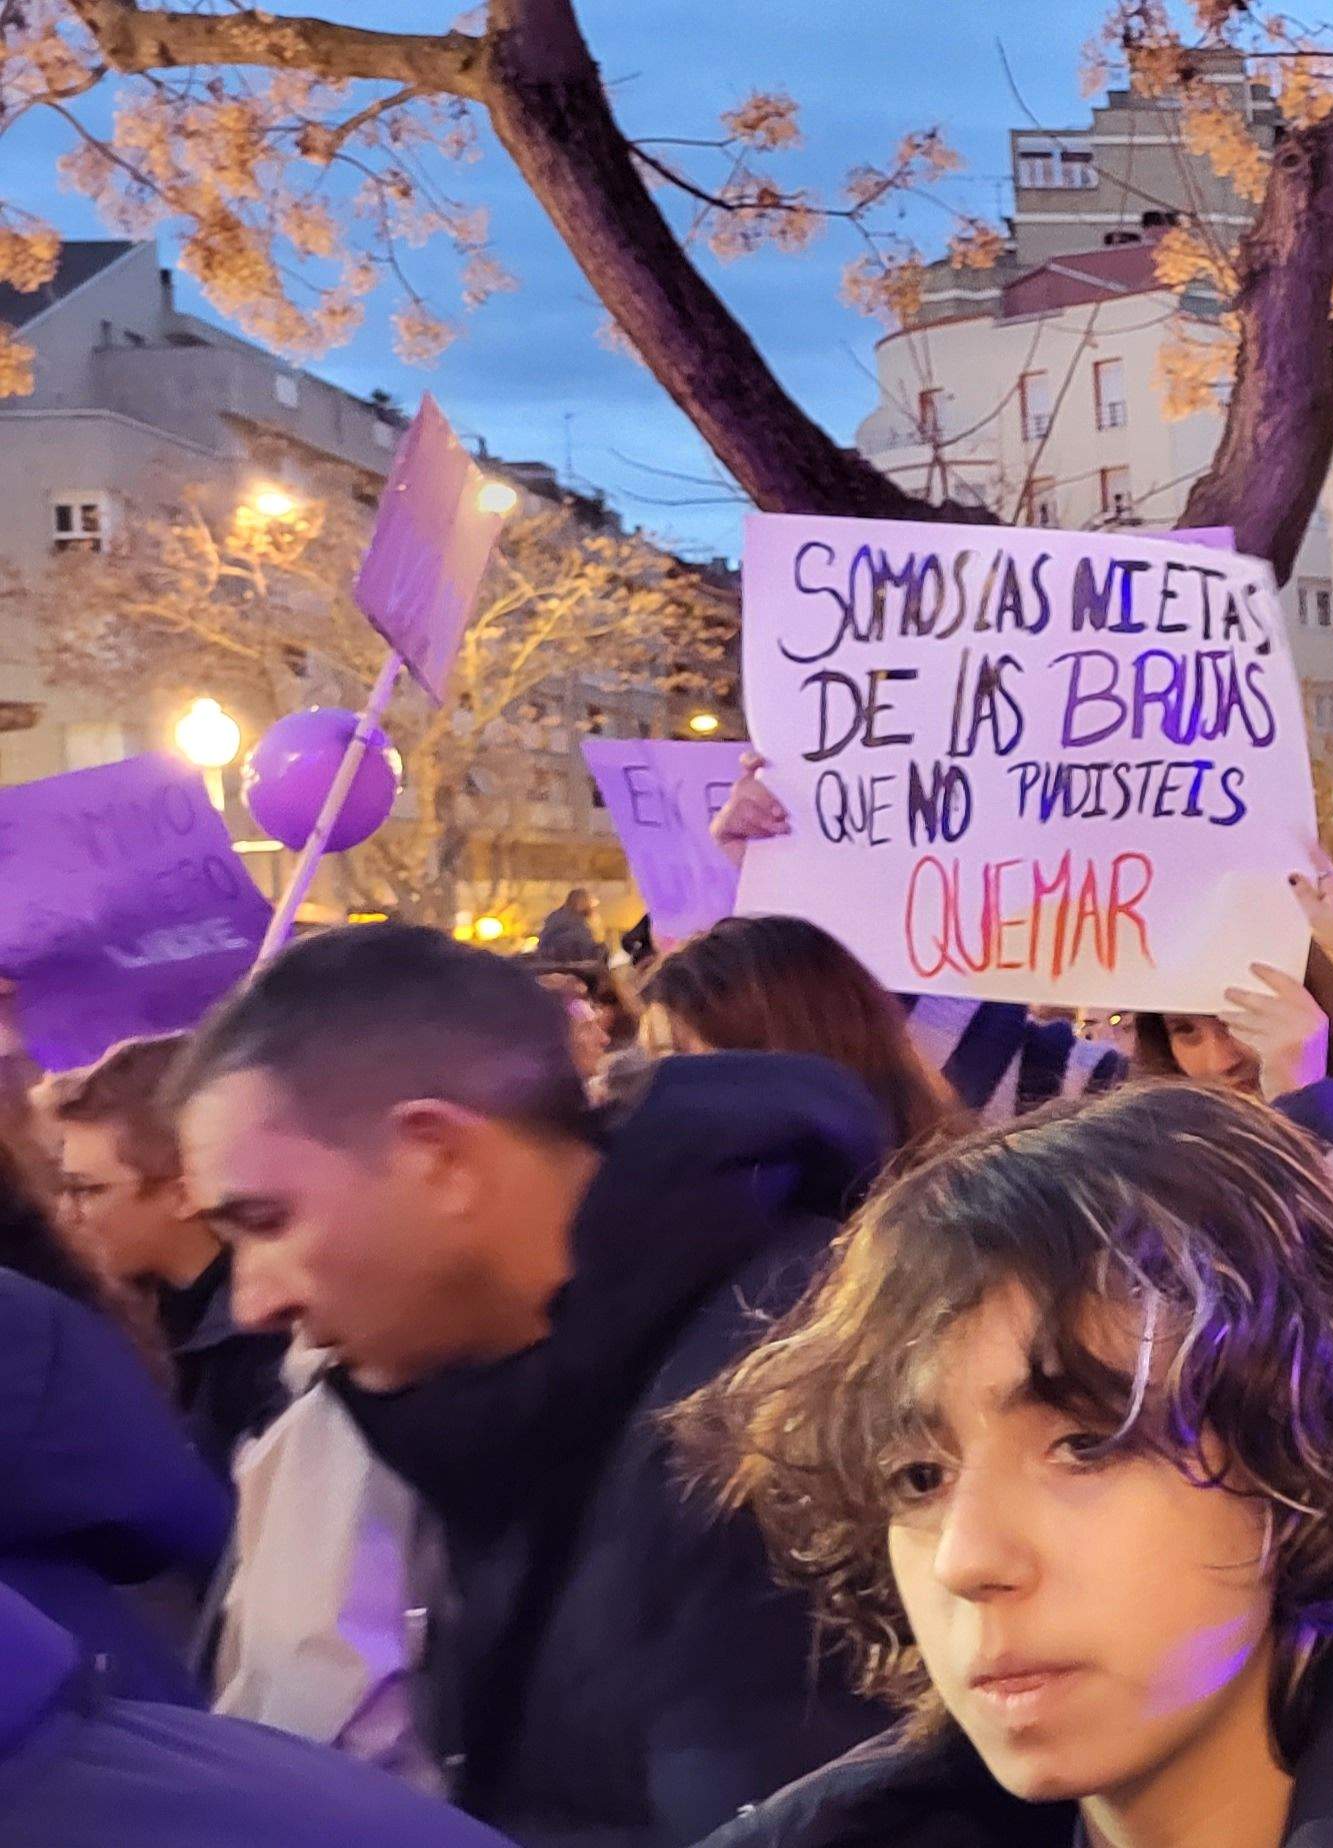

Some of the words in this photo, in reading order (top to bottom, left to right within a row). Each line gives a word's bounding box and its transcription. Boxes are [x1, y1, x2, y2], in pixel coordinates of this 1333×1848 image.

[778, 541, 969, 663] SOMOS
[974, 549, 1053, 635] LAS
[1071, 556, 1272, 655] NIETAS
[800, 668, 918, 763] DE
[948, 648, 1025, 757] LAS
[1047, 648, 1276, 749] BRUJAS
[815, 769, 896, 847] QUE
[907, 760, 973, 848] NO
[1006, 758, 1248, 827] PUDISTEIS
[905, 848, 1157, 981] QUEMAR
